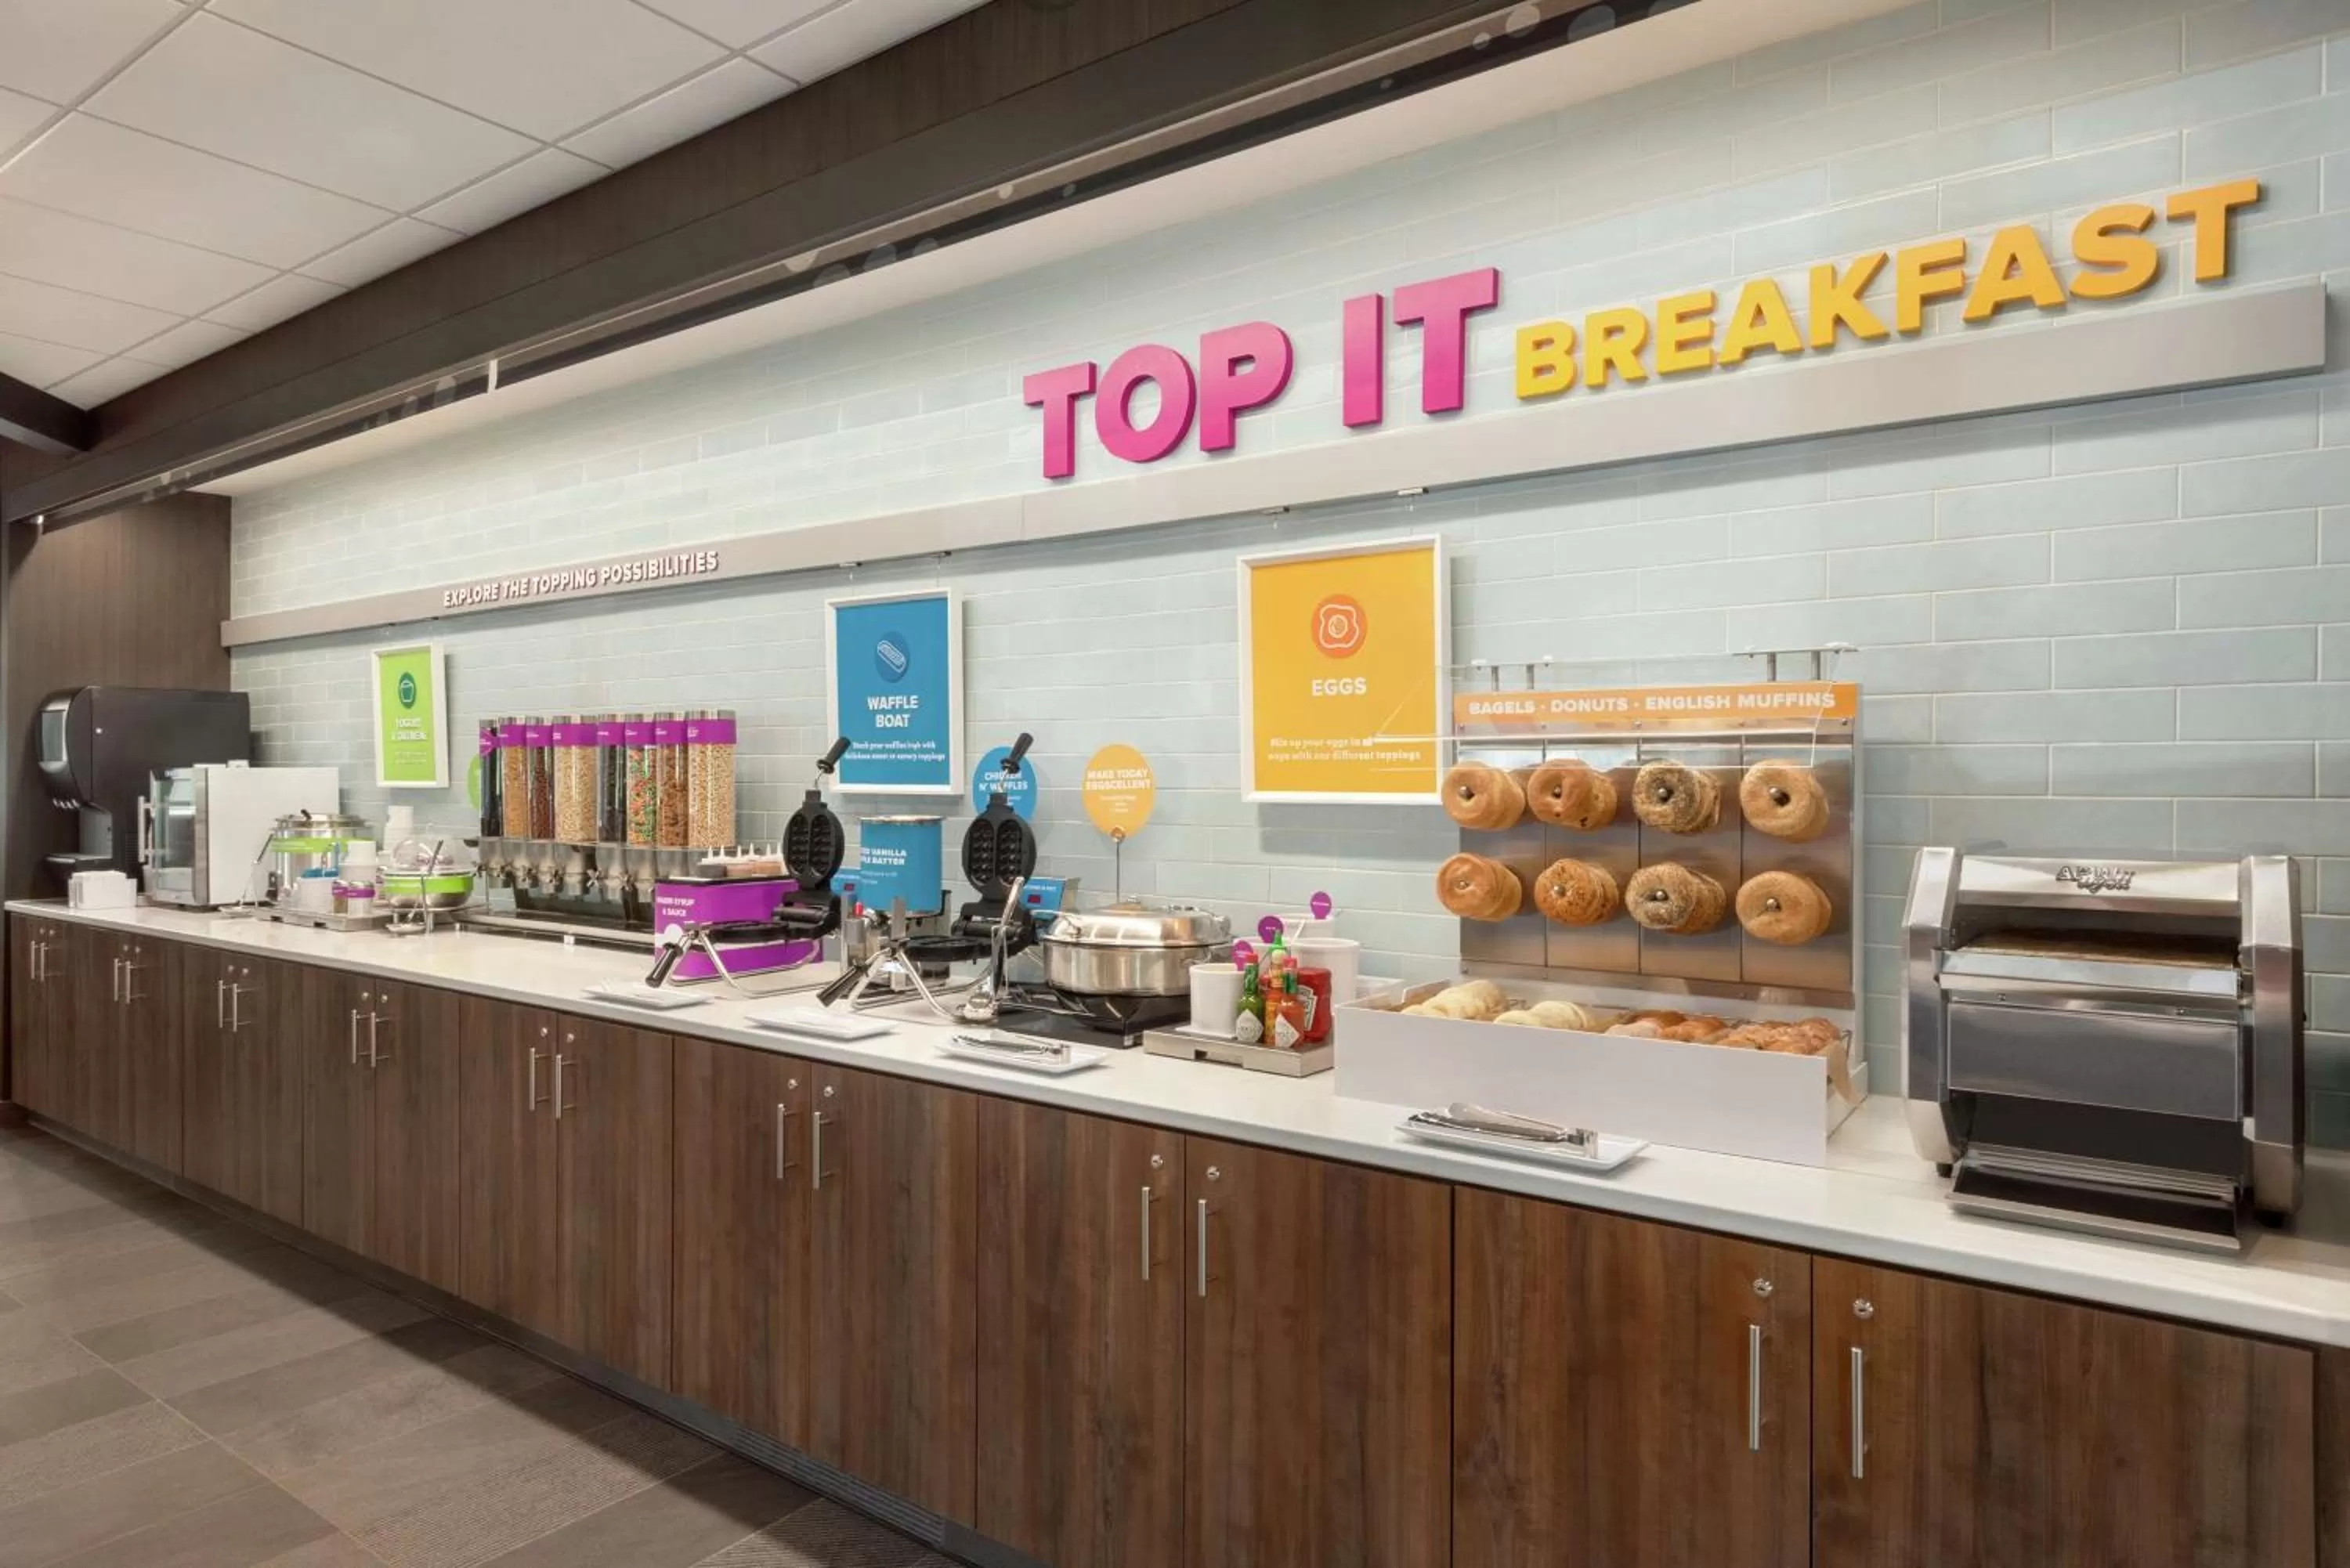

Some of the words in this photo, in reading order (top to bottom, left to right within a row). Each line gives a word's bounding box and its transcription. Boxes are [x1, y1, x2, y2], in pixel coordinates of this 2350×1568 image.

[1516, 177, 2261, 401] BREAKFAST
[1023, 321, 1294, 480] TOP
[1343, 267, 1500, 428] IT
[443, 583, 500, 609] EXPLORE
[501, 578, 528, 598] THE
[533, 568, 598, 594] TOPPING
[601, 551, 719, 586] POSSIBILITIES
[1311, 677, 1368, 696] EGGS
[867, 695, 919, 710] WAFFLE
[1469, 701, 1536, 715] BAGELS
[1551, 698, 1629, 714] DONUTS
[1646, 695, 1730, 710] ENGLISH
[1737, 692, 1836, 709] MUFFINS
[875, 714, 910, 728] BOAT
[989, 780, 1029, 792] WFFLES
[871, 847, 907, 857] VANILLA
